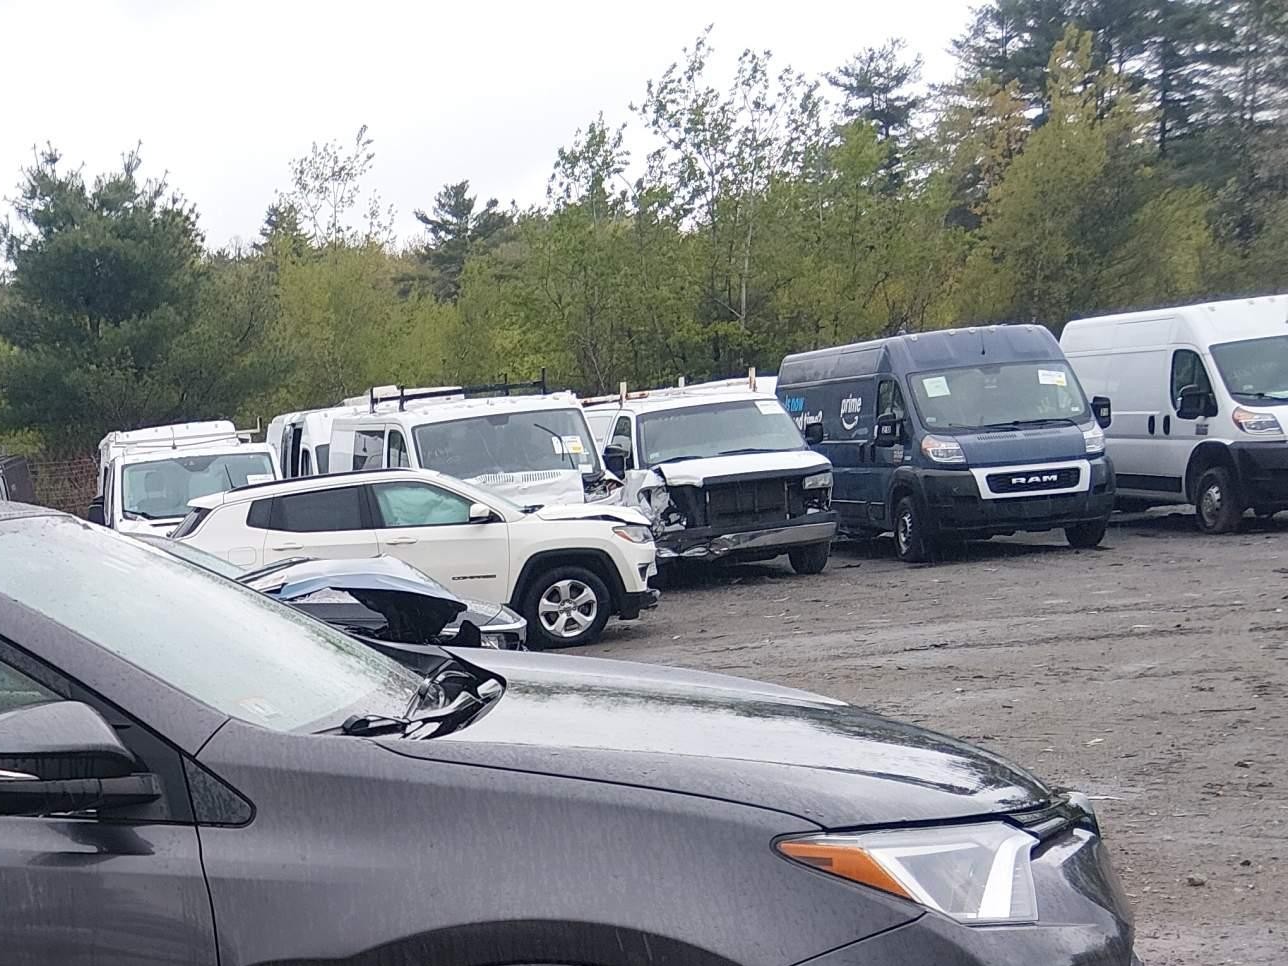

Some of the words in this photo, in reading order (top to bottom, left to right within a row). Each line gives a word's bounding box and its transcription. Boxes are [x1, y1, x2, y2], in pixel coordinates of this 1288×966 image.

[791, 397, 805, 412] now
[840, 392, 862, 418] prime
[1011, 474, 1058, 485] RAM
